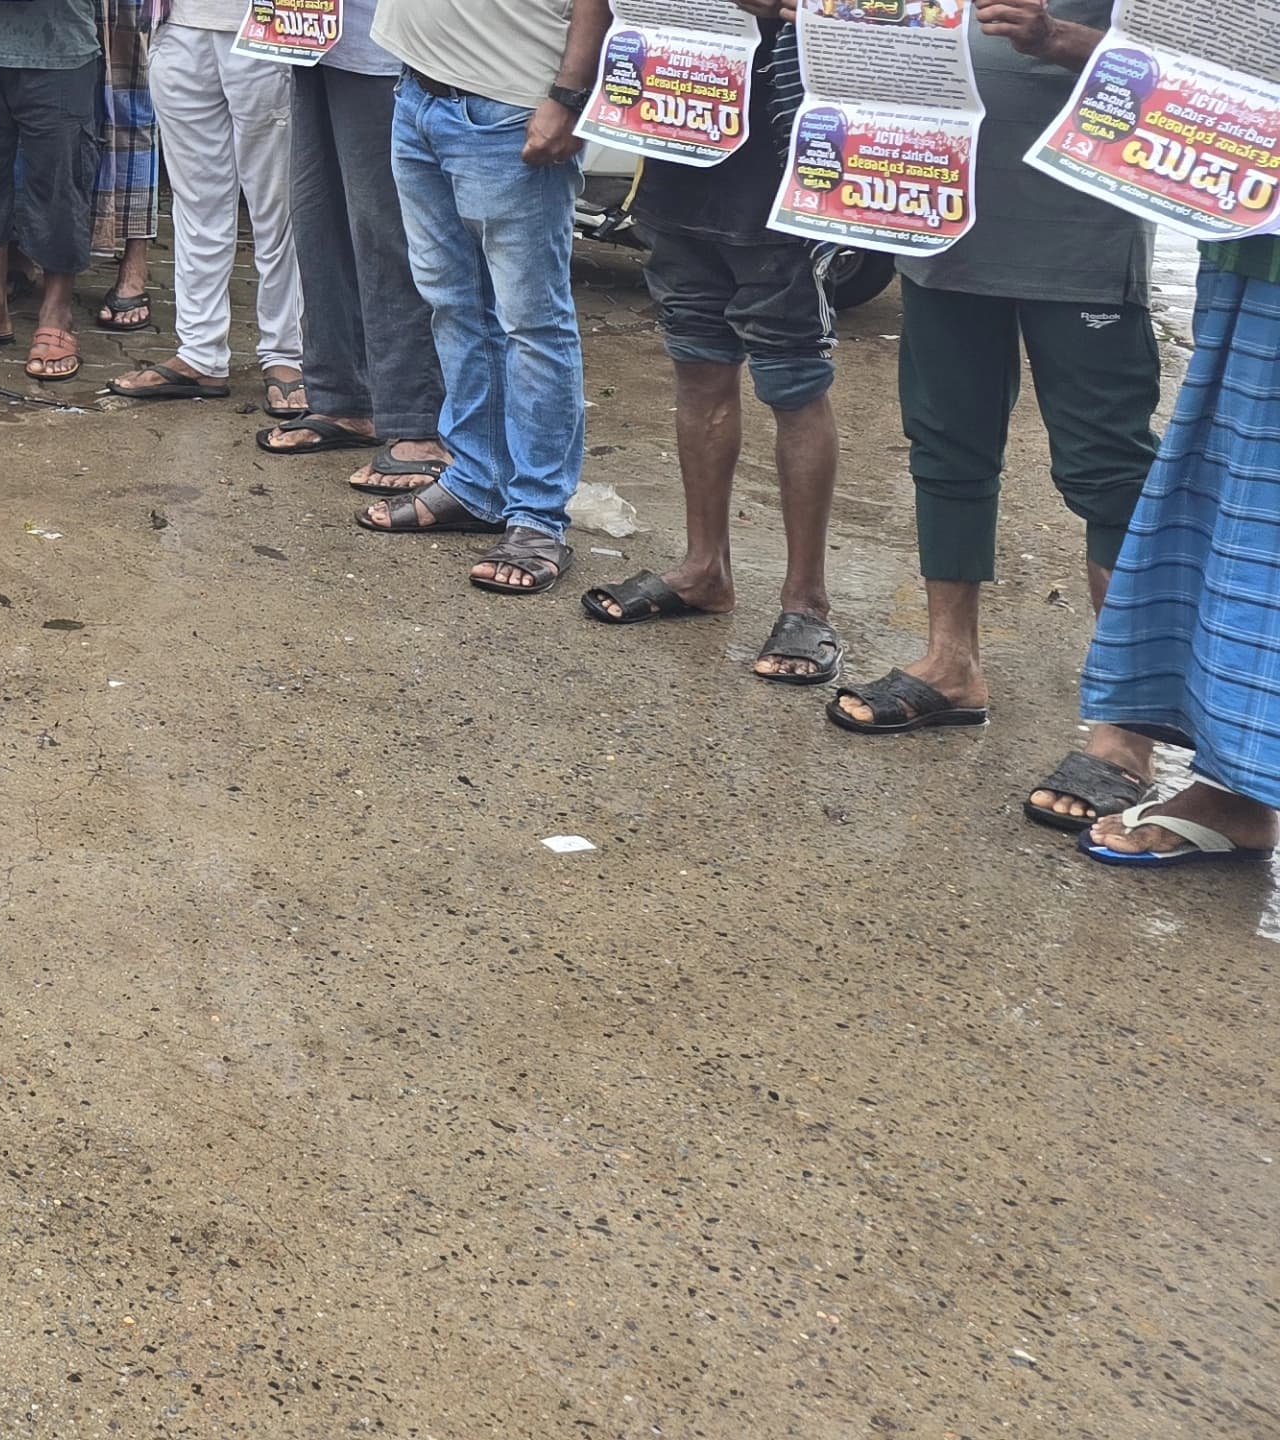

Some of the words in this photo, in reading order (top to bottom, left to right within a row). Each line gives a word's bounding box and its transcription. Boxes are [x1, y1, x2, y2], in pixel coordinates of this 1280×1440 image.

[275, 10, 337, 44] ಮುಷ್ಕರ
[641, 91, 740, 140] ಮುಷ್ಕರ
[1189, 93, 1229, 114] JCTU
[874, 130, 904, 145] JCTU
[1123, 128, 1278, 210] ಮುಷ್ಕರ
[841, 173, 964, 227] ಮುಷ್ಕರ
